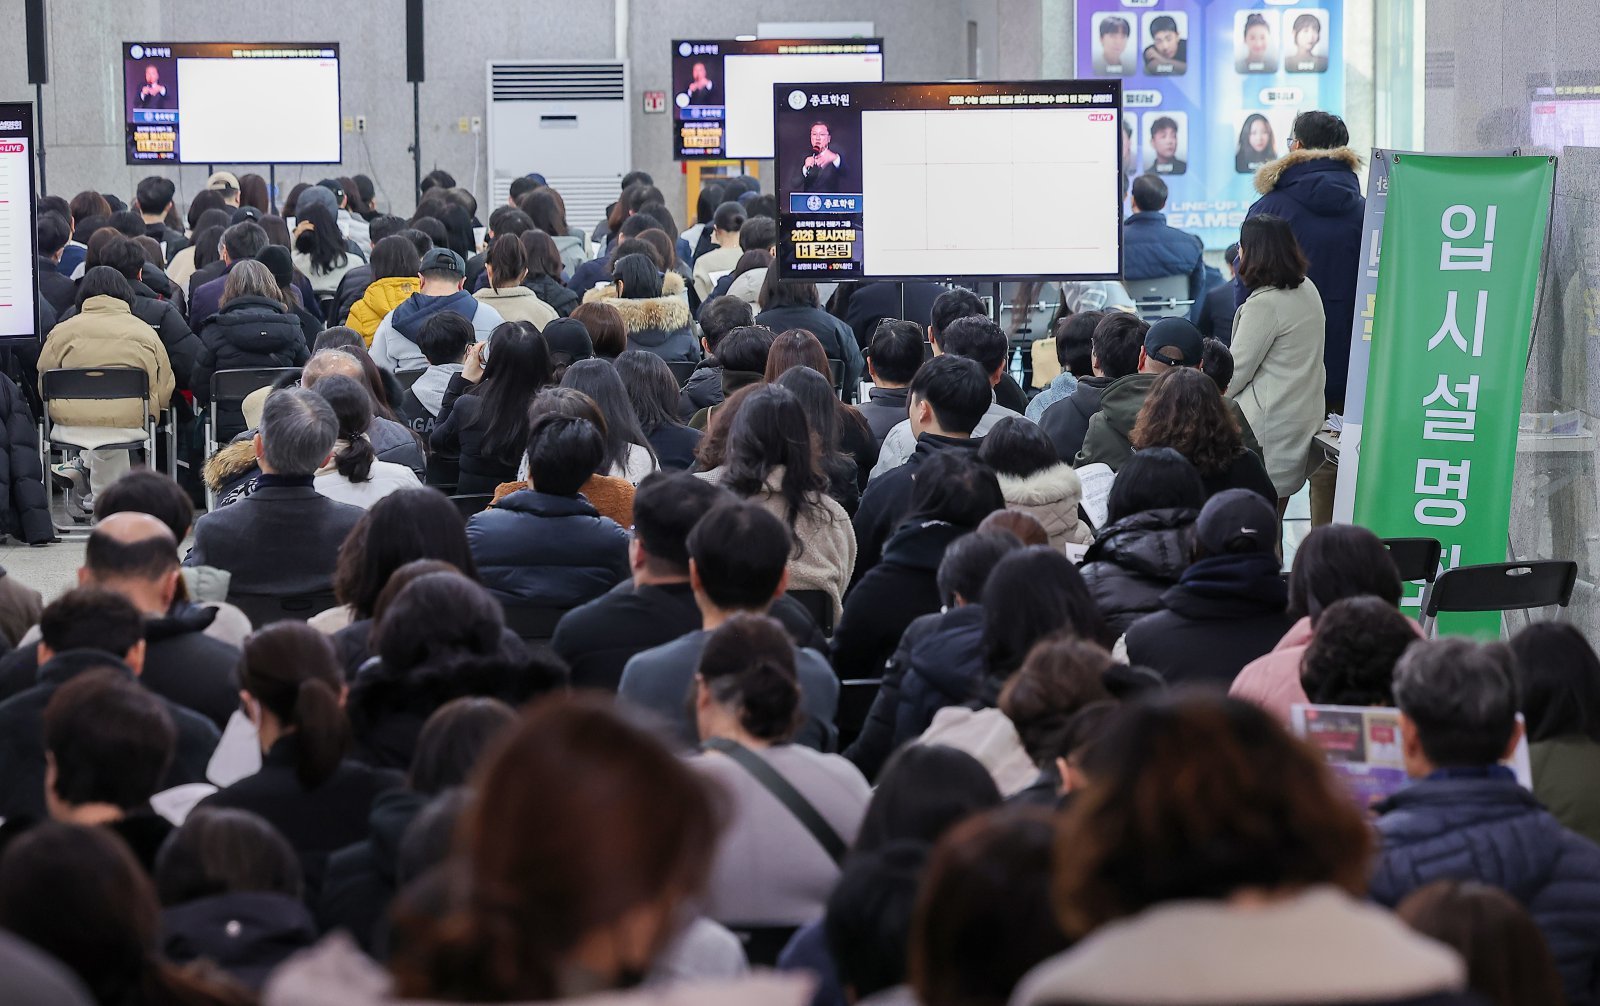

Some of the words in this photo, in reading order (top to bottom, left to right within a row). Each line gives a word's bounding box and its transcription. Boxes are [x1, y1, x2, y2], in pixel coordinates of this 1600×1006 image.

[809, 93, 850, 107] 종로학원
[4, 144, 22, 152] LIVE
[823, 198, 855, 209] 종로학원
[1171, 200, 1238, 212] LINE-UP
[791, 229, 815, 241] 2026
[815, 229, 856, 241] 정시지원
[798, 244, 811, 257] 1:1
[814, 243, 849, 257] 컨설팅
